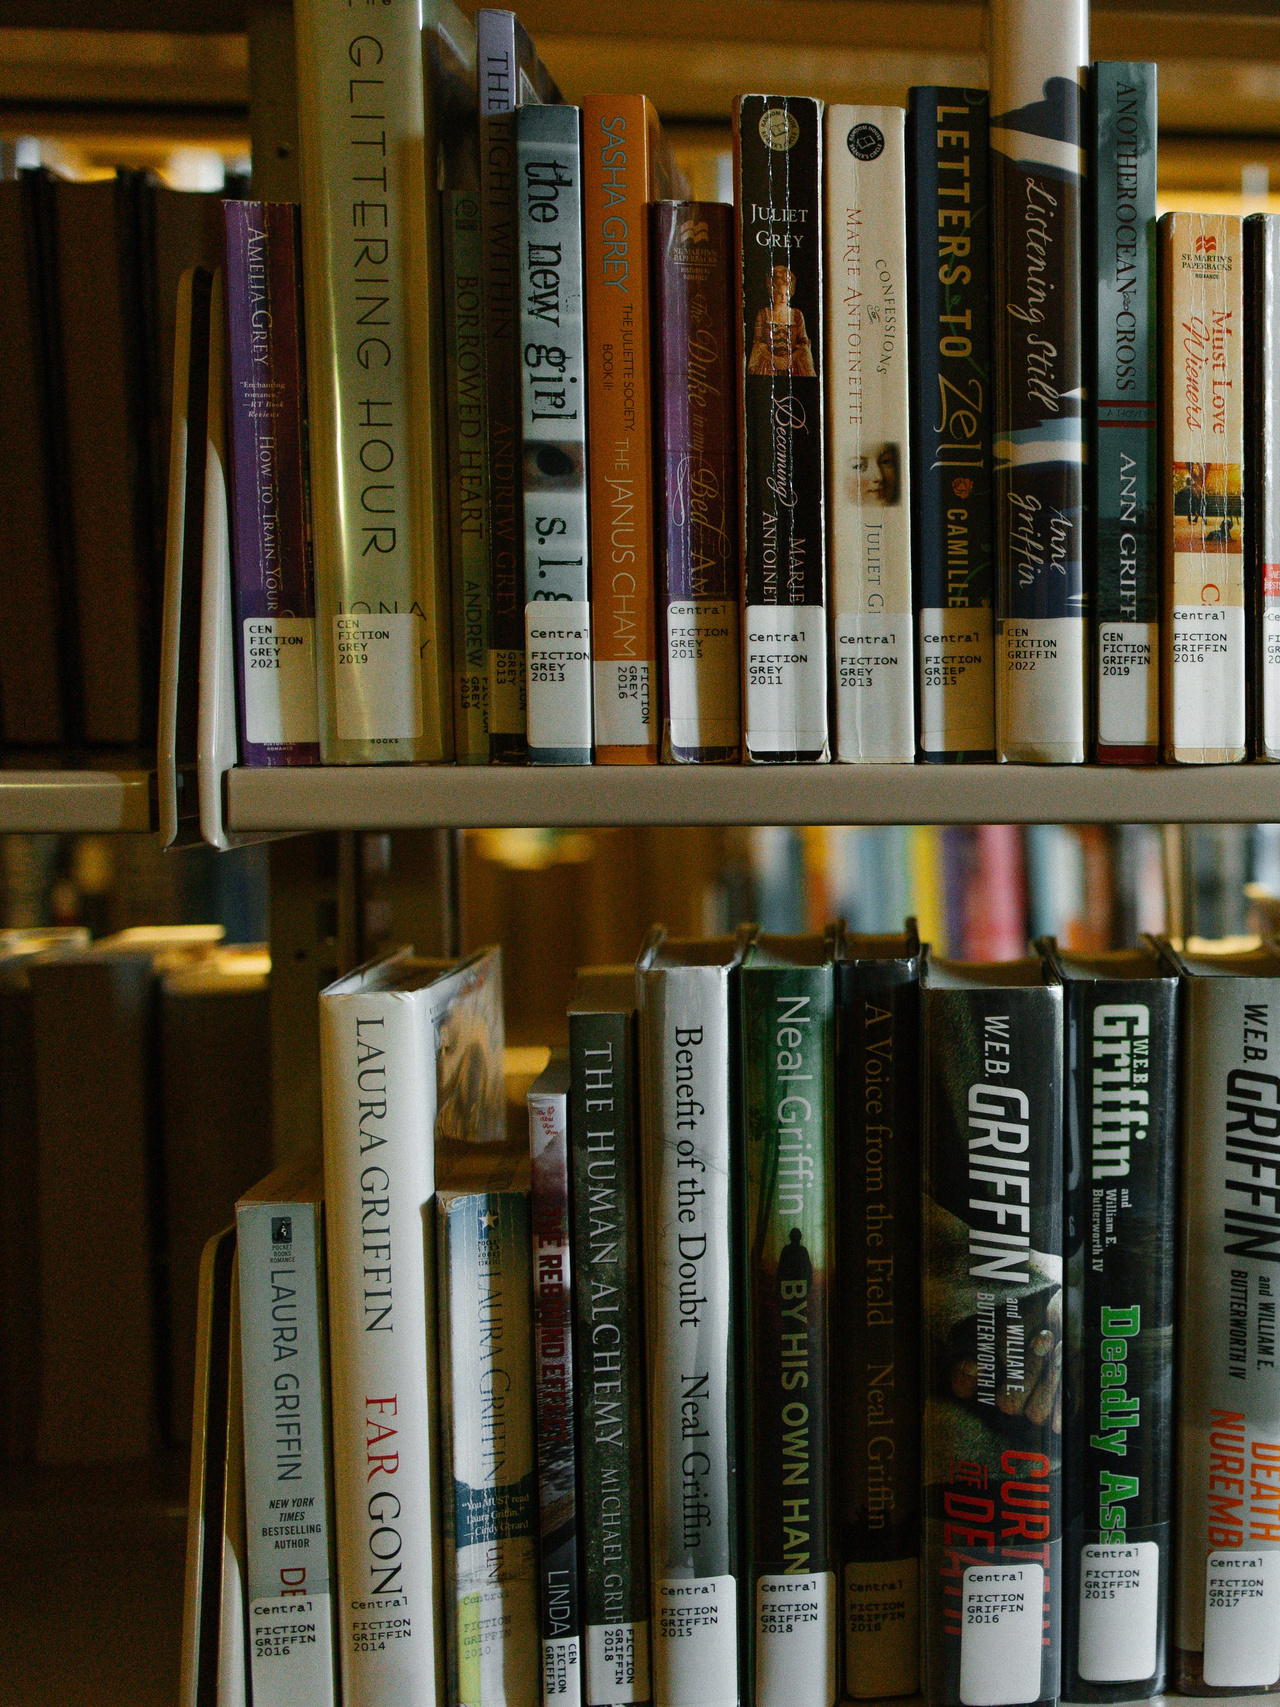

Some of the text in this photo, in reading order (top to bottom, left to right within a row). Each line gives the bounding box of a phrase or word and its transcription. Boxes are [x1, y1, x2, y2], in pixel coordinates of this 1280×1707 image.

[349, 34, 392, 370] GLITTERING
[600, 116, 629, 294] SASHA GREY
[751, 204, 808, 223] JULIET
[755, 231, 804, 248] GREY
[937, 106, 972, 357] LETTERS TO
[1115, 82, 1138, 391] ANOTHER OCEAN CROSS
[247, 227, 273, 367] AMELIA GREY
[524, 160, 577, 422] the new girl
[841, 208, 863, 426] MARIE ANTOINETTE
[875, 259, 895, 375] CONFESSIONS
[1007, 178, 1059, 412] Listening Still
[456, 276, 484, 539] BORROWED HEART
[622, 303, 635, 432] THE JULIETTE SOCIETY,
[1180, 315, 1210, 433] Wieners
[1211, 309, 1232, 434] Must Love
[358, 398, 397, 557] HOUR
[766, 395, 810, 507] Becoming
[1120, 453, 1136, 523] ANN
[258, 435, 280, 611] HOW TO TRAIN YOUR
[605, 438, 637, 657] THE JANUS CHAM
[864, 524, 883, 585] JULIET
[947, 508, 969, 607] CAMILLE
[1050, 505, 1074, 575] Anne
[789, 537, 805, 603] MARIE
[338, 631, 390, 640] FICTION
[338, 643, 367, 652] GREY
[339, 655, 368, 664] 2019
[465, 580, 482, 668] ANDREW
[749, 633, 805, 642] Central
[924, 634, 978, 642] Central
[926, 656, 981, 664] FICTION
[1103, 633, 1123, 641] CEN
[1103, 644, 1150, 652] FICTION
[1103, 656, 1150, 664] GRIFFIN
[750, 676, 782, 684] 2011
[926, 676, 957, 685] 2015
[1103, 667, 1129, 675] 2019
[1243, 1004, 1268, 1064] W.E.B.
[777, 996, 815, 1215] Neal Griffin
[1092, 1004, 1150, 1180] Griffin
[356, 1017, 394, 1334] LAURA GRIFFIN
[675, 1026, 707, 1328] Benefit of the Doubt
[865, 1002, 894, 1327] A Voice from the Field
[968, 1015, 1030, 1283] W.E.B. GRIFFIN
[584, 1042, 623, 1446] THE HUMAN ALCHEMY
[1092, 1189, 1104, 1272] Butterworth IV
[539, 1253, 568, 1441] REBOUND EFFECT
[977, 1292, 996, 1406] BUTTERWORTH IV
[1005, 1298, 1024, 1396] and WILLIAM E.
[1228, 1269, 1249, 1381] BUTTERWORTH IV
[1257, 1276, 1275, 1371] and WILLIAM E.
[270, 1269, 302, 1482] LAURA GRIFFIN
[681, 1373, 711, 1551] Neal Griffin
[780, 1279, 811, 1575] BY HIS OWN HAN
[867, 1363, 896, 1530] Neal Griffin
[262, 1524, 321, 1536] BESTSELLING
[269, 1497, 315, 1509] NEW YORK
[279, 1512, 306, 1522] TIMES
[365, 1393, 404, 1596] FAR GON
[600, 1468, 621, 1565] MICHAEL
[274, 1539, 310, 1550] AUTHOR
[1085, 1580, 1139, 1589] GRIFFIN
[1086, 1549, 1138, 1558] Central
[1086, 1569, 1139, 1578] FICTION
[254, 1601, 313, 1614] Central
[255, 1624, 315, 1636] FICTION
[546, 1570, 570, 1636] LINDA
[660, 1584, 716, 1595] Central
[661, 1606, 718, 1616] FICTION
[661, 1617, 718, 1627] GRIFFIN
[850, 1601, 905, 1611] FICTION
[1085, 1590, 1115, 1599] 2015
[255, 1635, 316, 1646] GRIFFIN
[256, 1646, 290, 1657] 2016
[661, 1628, 692, 1637] 2015
